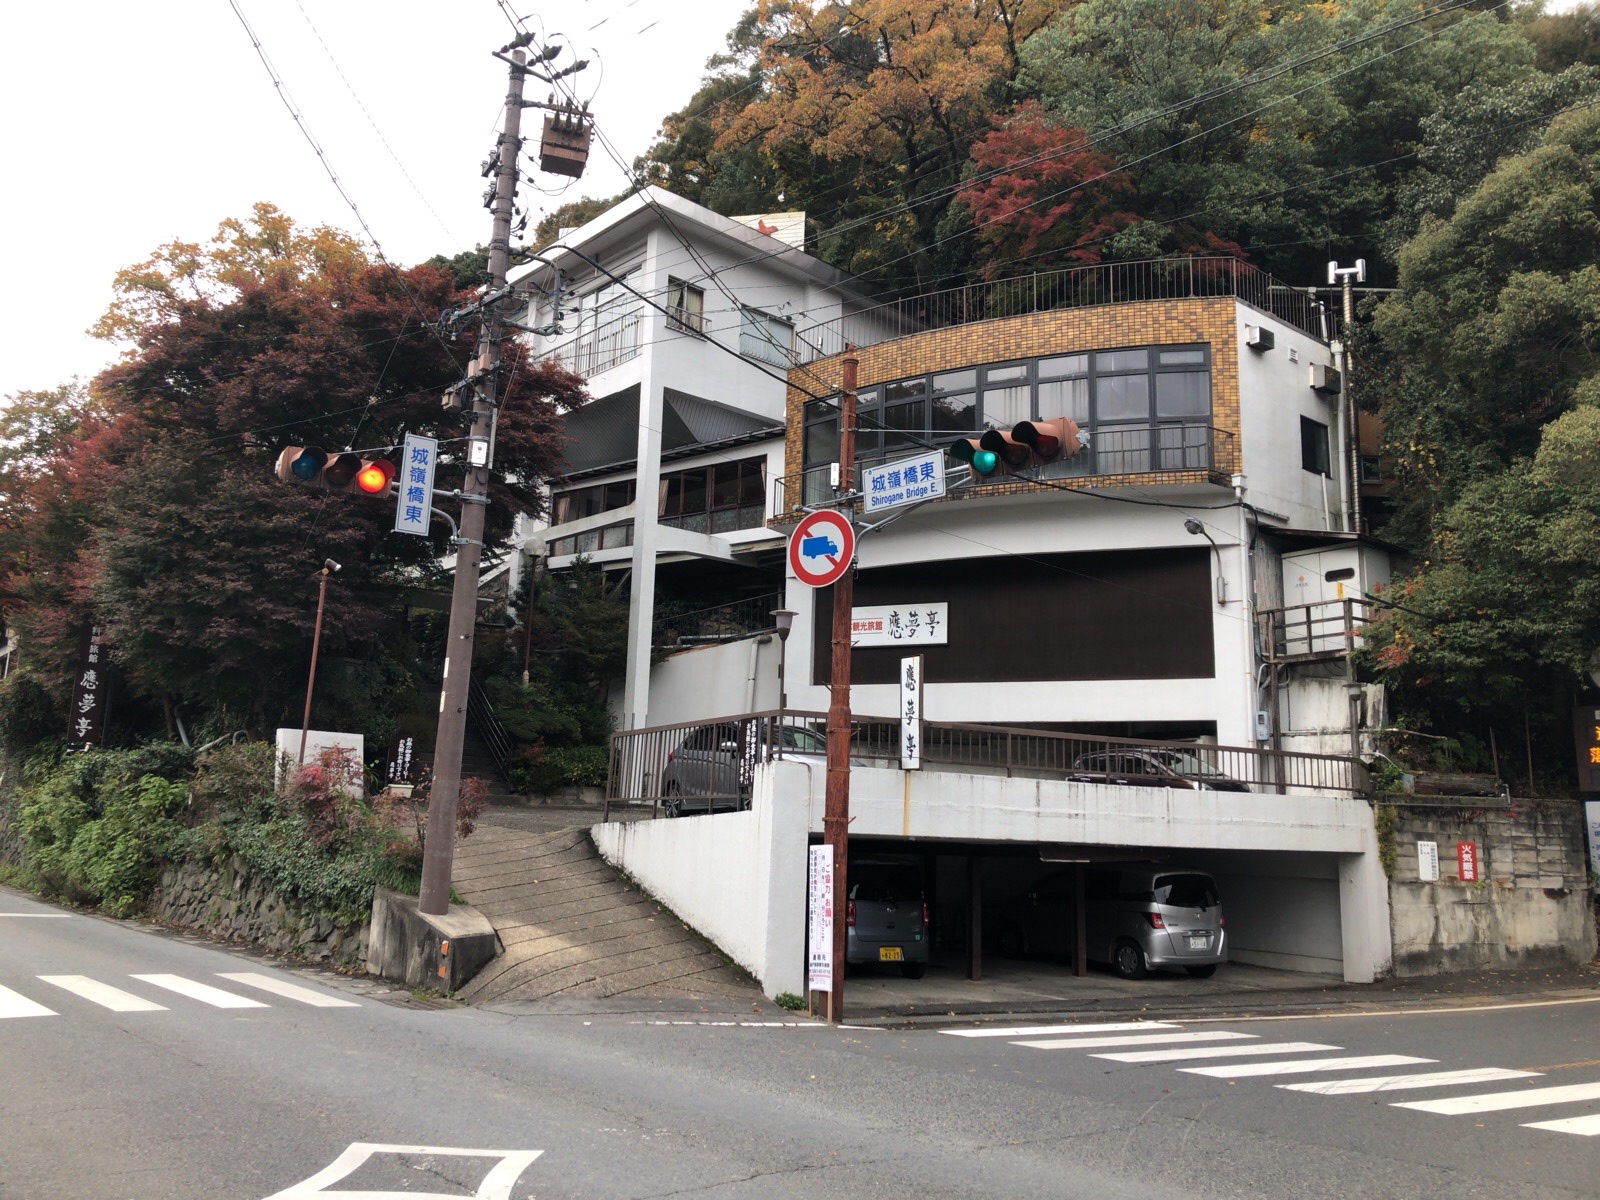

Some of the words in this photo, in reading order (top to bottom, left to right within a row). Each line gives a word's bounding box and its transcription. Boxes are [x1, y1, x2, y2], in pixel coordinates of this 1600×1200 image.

[404, 446, 429, 524] 城嶺橋東
[871, 461, 935, 492] 城嶺橋東
[871, 493, 904, 507] Shirogane
[906, 486, 928, 499] Bridge
[930, 482, 938, 493] E.
[75, 669, 98, 737] 應夢亭
[905, 664, 917, 761] 應夢亭
[1461, 844, 1474, 880] 火気厳禁
